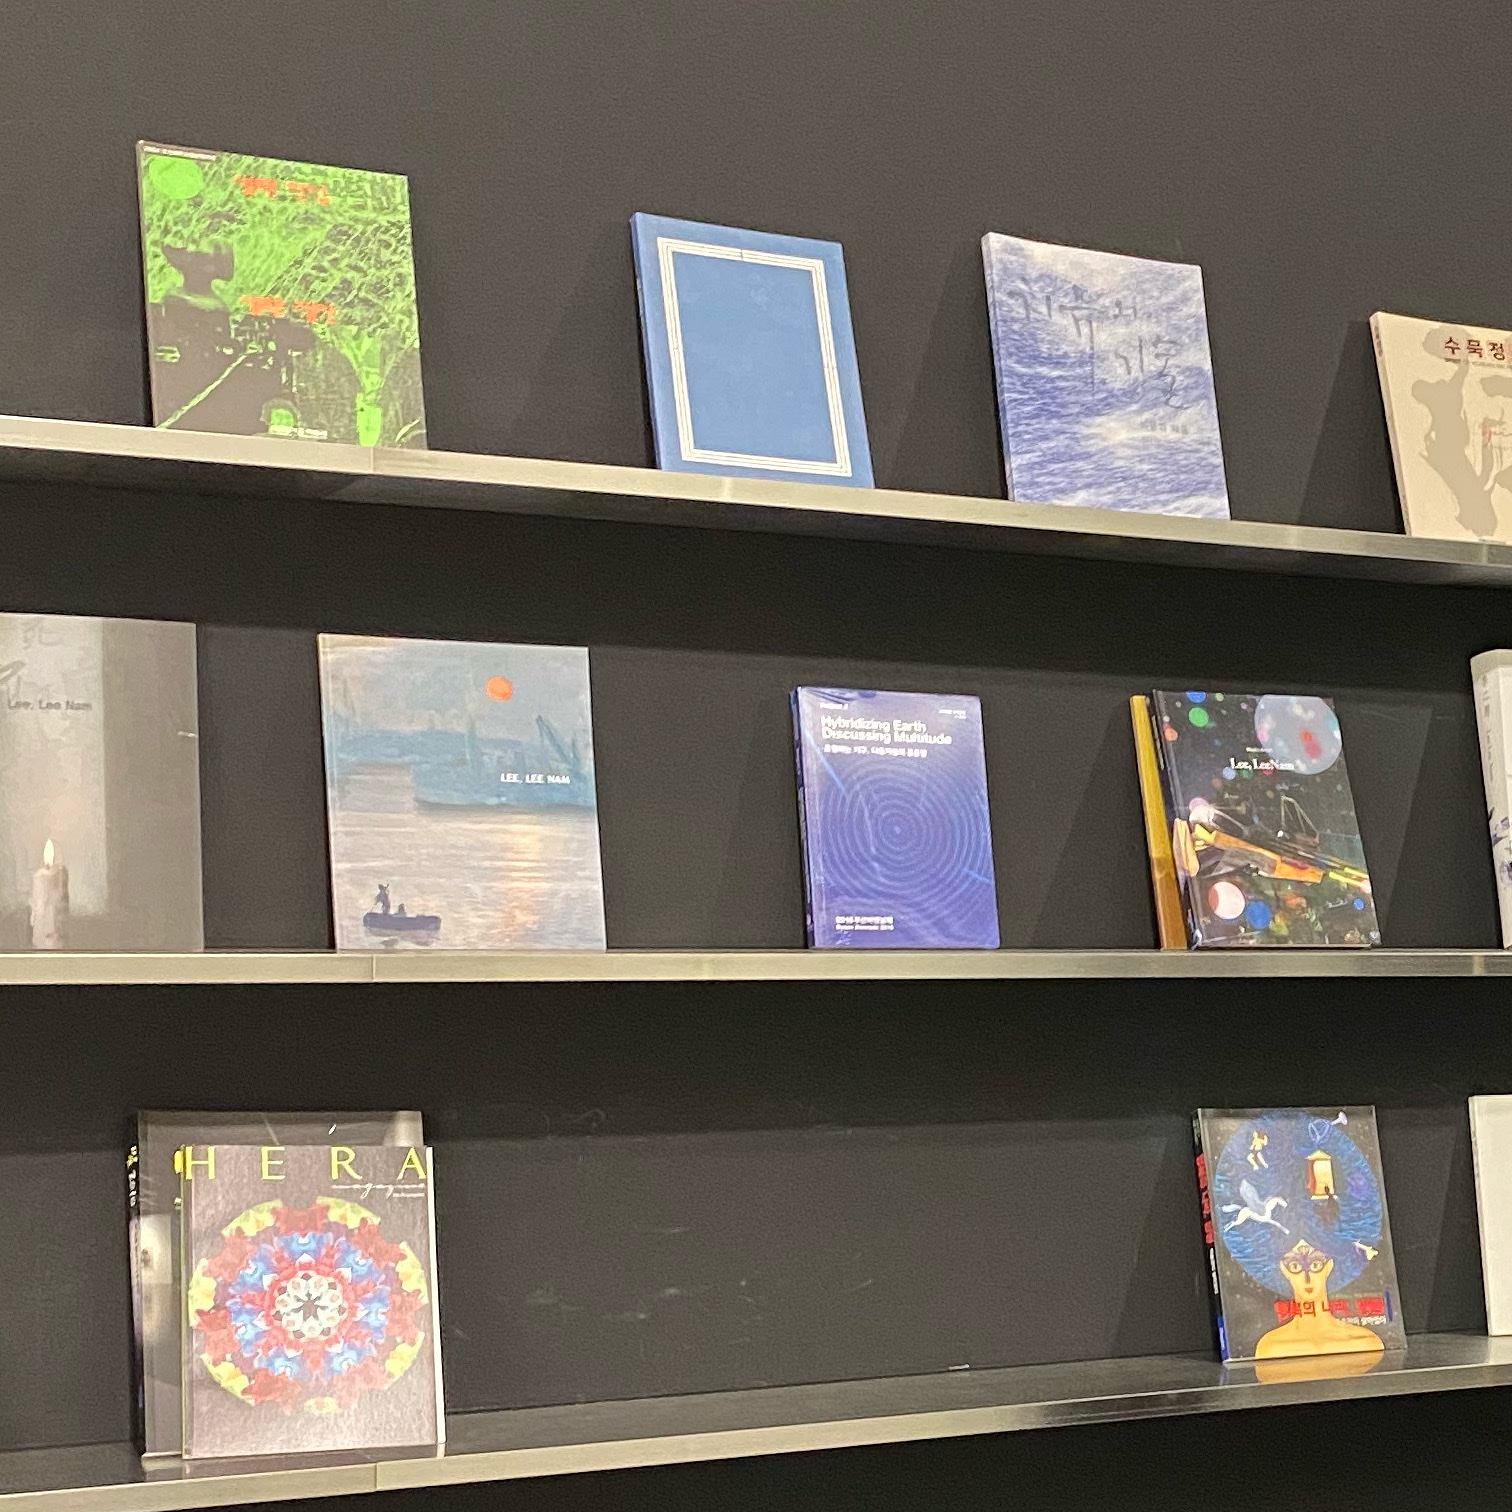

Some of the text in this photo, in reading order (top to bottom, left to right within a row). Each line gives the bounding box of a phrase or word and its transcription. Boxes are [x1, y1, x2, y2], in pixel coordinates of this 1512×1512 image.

[820, 715, 927, 733] Hybridizing Earth
[821, 727, 953, 745] Discussing Multitude
[525, 773, 545, 784] LEE
[547, 774, 571, 785] NAM
[184, 1146, 427, 1182] HERA
